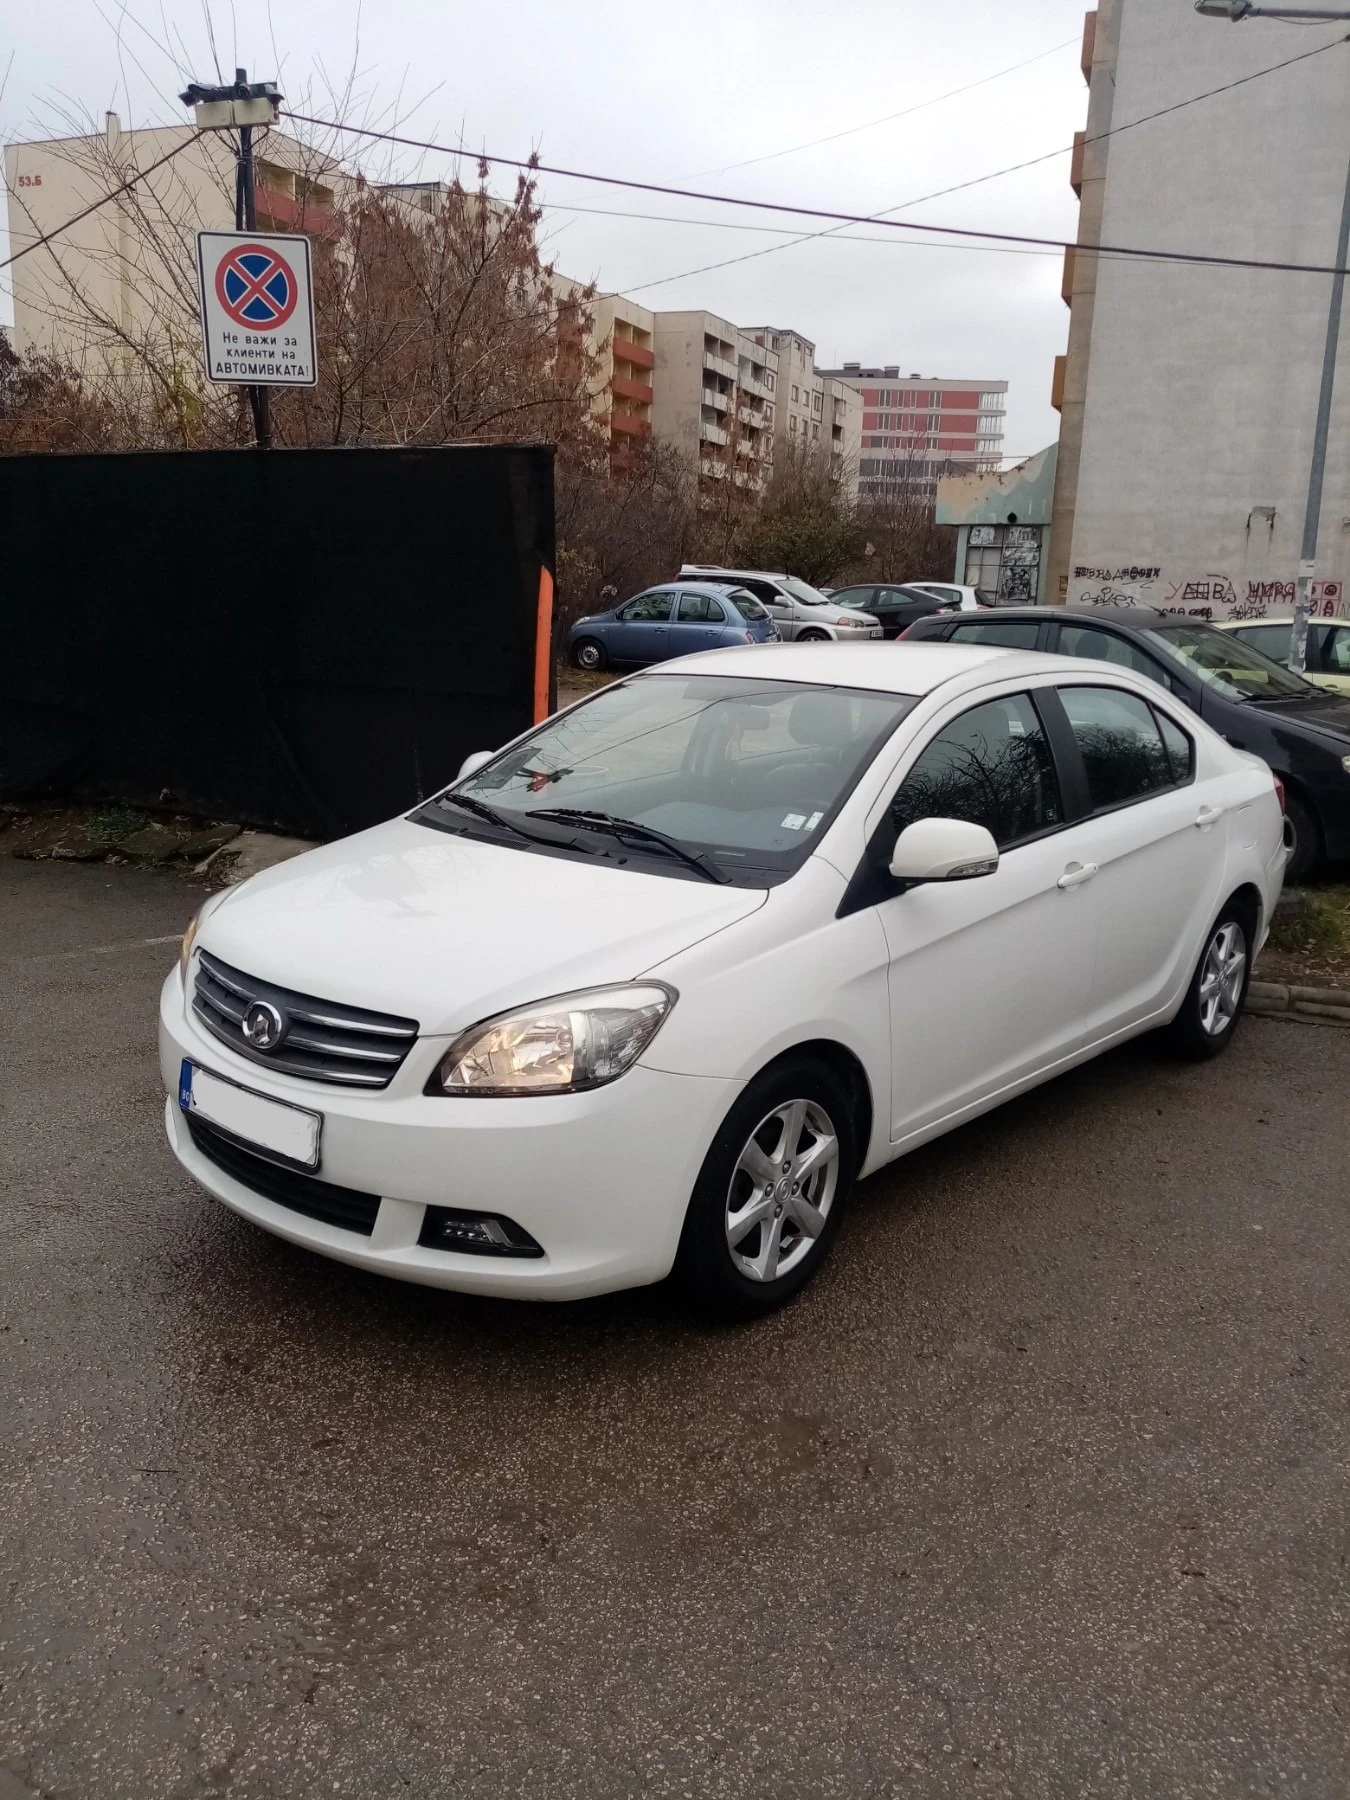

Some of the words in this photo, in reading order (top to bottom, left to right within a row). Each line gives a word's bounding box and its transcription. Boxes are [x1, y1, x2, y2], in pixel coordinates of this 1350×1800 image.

[222, 331, 239, 344] Не
[245, 335, 277, 346] важи
[284, 337, 298, 347] за
[226, 348, 275, 359] клиенти
[282, 350, 296, 360] на
[216, 362, 309, 377] АВТОМИВКАТА!
[181, 1089, 190, 1102] BG
